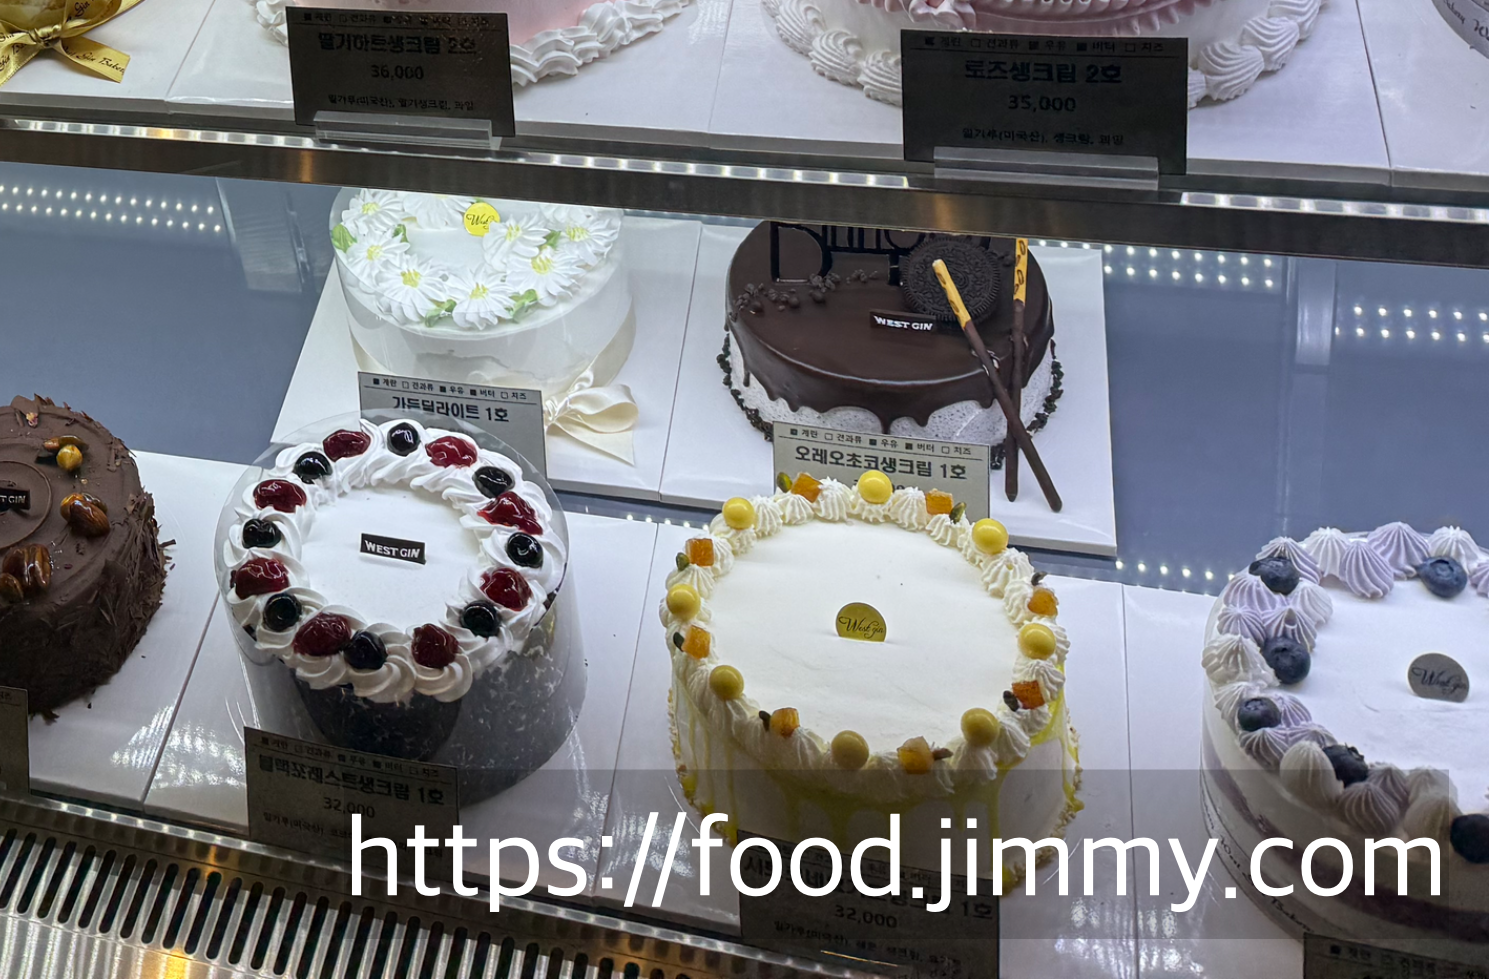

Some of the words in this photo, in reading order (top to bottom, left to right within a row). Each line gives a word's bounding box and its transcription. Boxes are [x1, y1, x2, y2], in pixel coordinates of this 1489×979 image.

[446, 34, 479, 56] 2호
[369, 63, 426, 82] 36,000
[963, 58, 1078, 85] 로즈생크림
[1084, 62, 1124, 85] 2호
[1007, 93, 1078, 114] 35,000
[872, 314, 911, 330] WEST
[911, 321, 934, 333] GIN
[381, 377, 399, 388] 계란
[411, 381, 435, 392] 견과류
[448, 385, 465, 395] 우유
[478, 388, 497, 399] 버터
[510, 390, 528, 401] 치즈
[391, 395, 481, 421] 가든딜라이트
[484, 405, 511, 423] 1호
[800, 428, 820, 440] 계란
[835, 432, 863, 444] 견과류
[879, 436, 900, 449] 우유
[915, 441, 936, 454] 버터
[952, 444, 973, 456] 치즈
[794, 444, 933, 478] 오레오초코생크림
[938, 462, 968, 481] 1호
[8, 494, 27, 505] GIN
[364, 539, 399, 557] WEST
[399, 547, 421, 559] GIN
[258, 753, 411, 801] 블랙포레스트생크림
[417, 786, 445, 806] 1호
[322, 796, 377, 819] 32,000
[833, 904, 899, 929] 32,000
